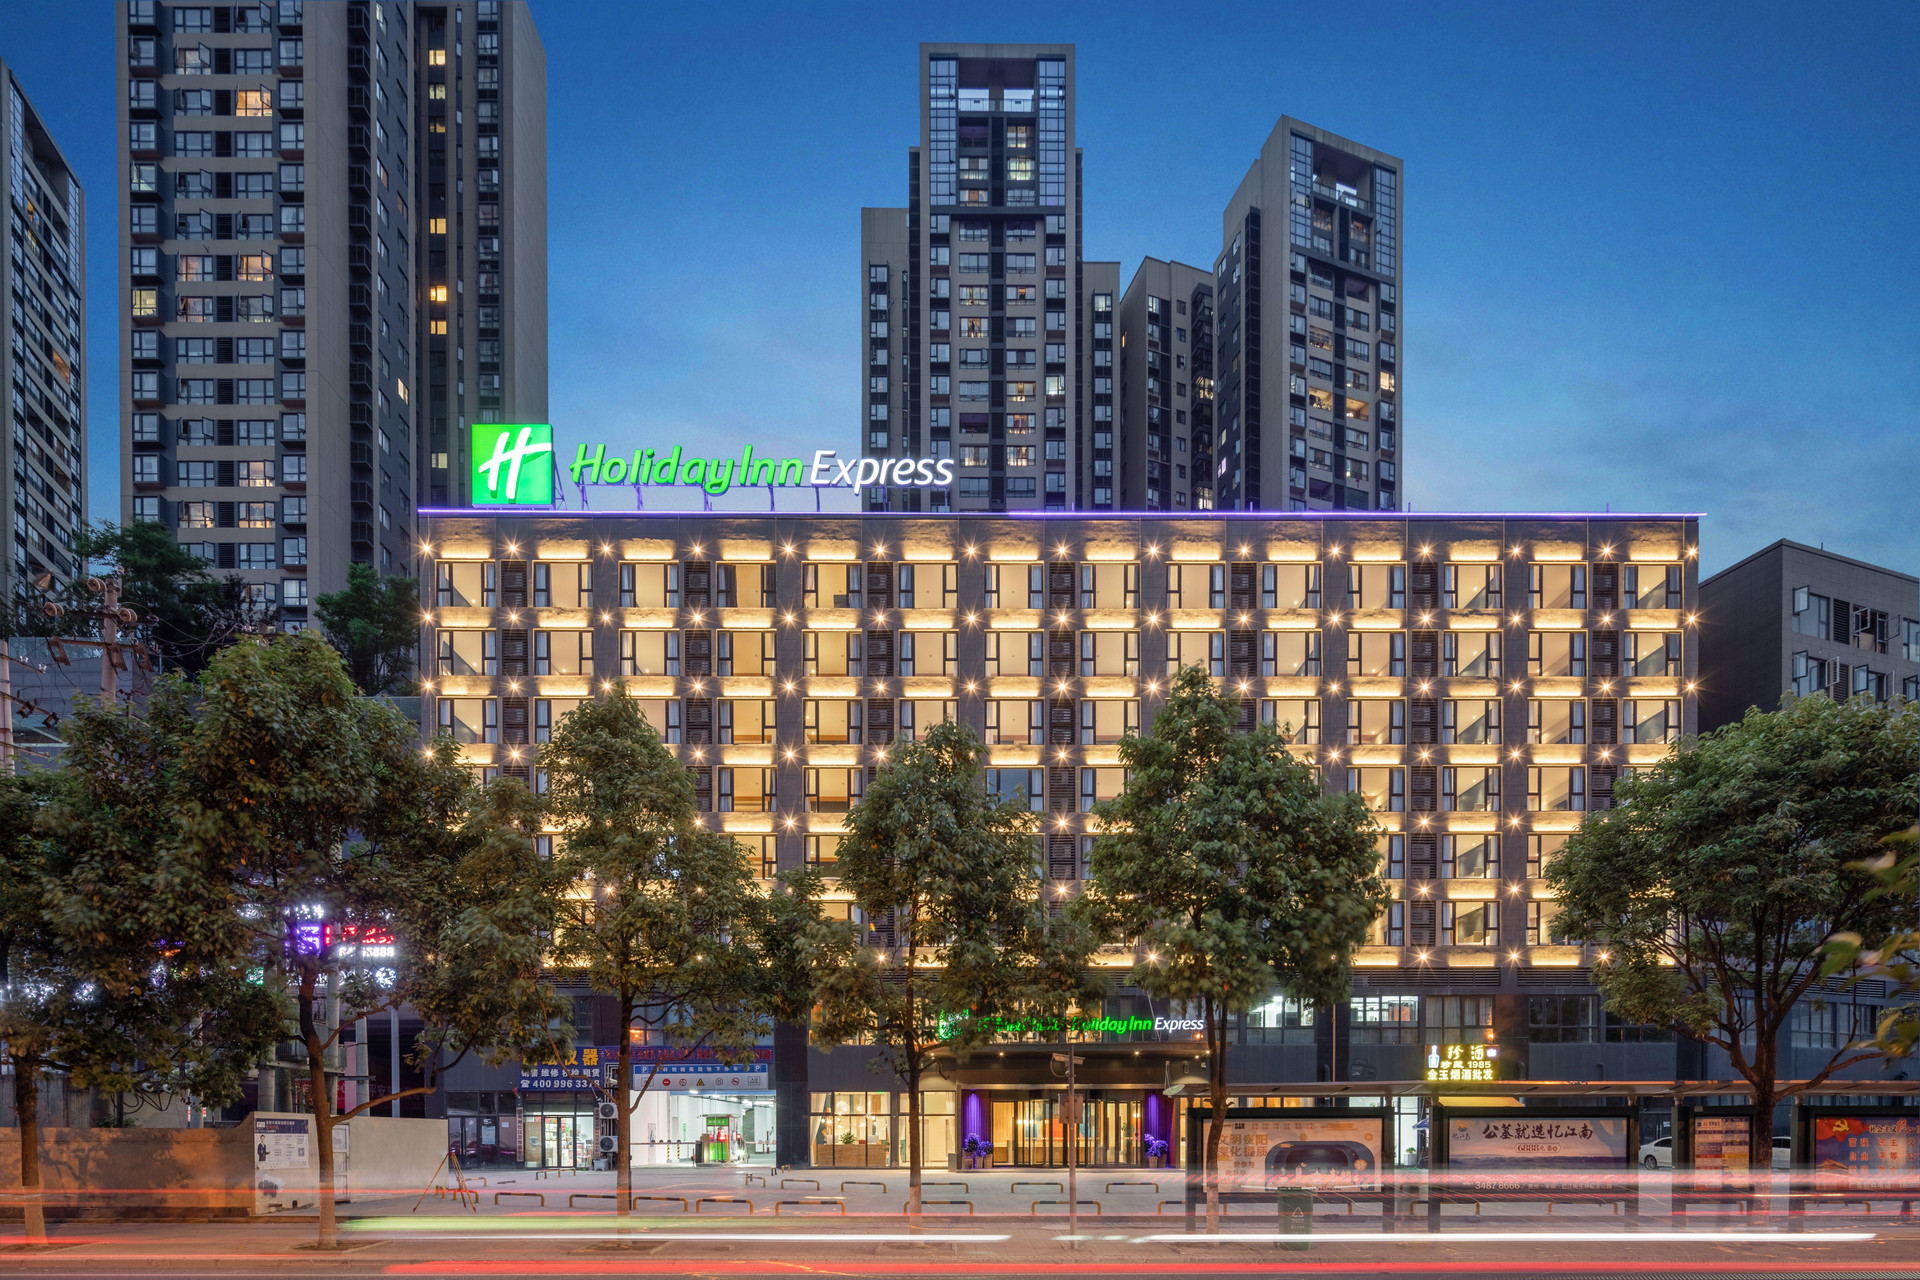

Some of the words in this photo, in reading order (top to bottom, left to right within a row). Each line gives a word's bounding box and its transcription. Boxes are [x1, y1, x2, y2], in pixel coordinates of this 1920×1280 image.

[570, 443, 734, 494] Holiday
[738, 444, 804, 486] Inn
[810, 450, 954, 495] Express
[1129, 1015, 1152, 1031] Inn
[1154, 1017, 1204, 1033] Express
[532, 1080, 552, 1088] 400
[553, 1080, 573, 1088] 996
[575, 1080, 600, 1088] 338
[1483, 1123, 1593, 1140] 公墓就选忆江南
[1218, 1134, 1268, 1145] 文明贵阳
[1217, 1146, 1268, 1157] 深化提质
